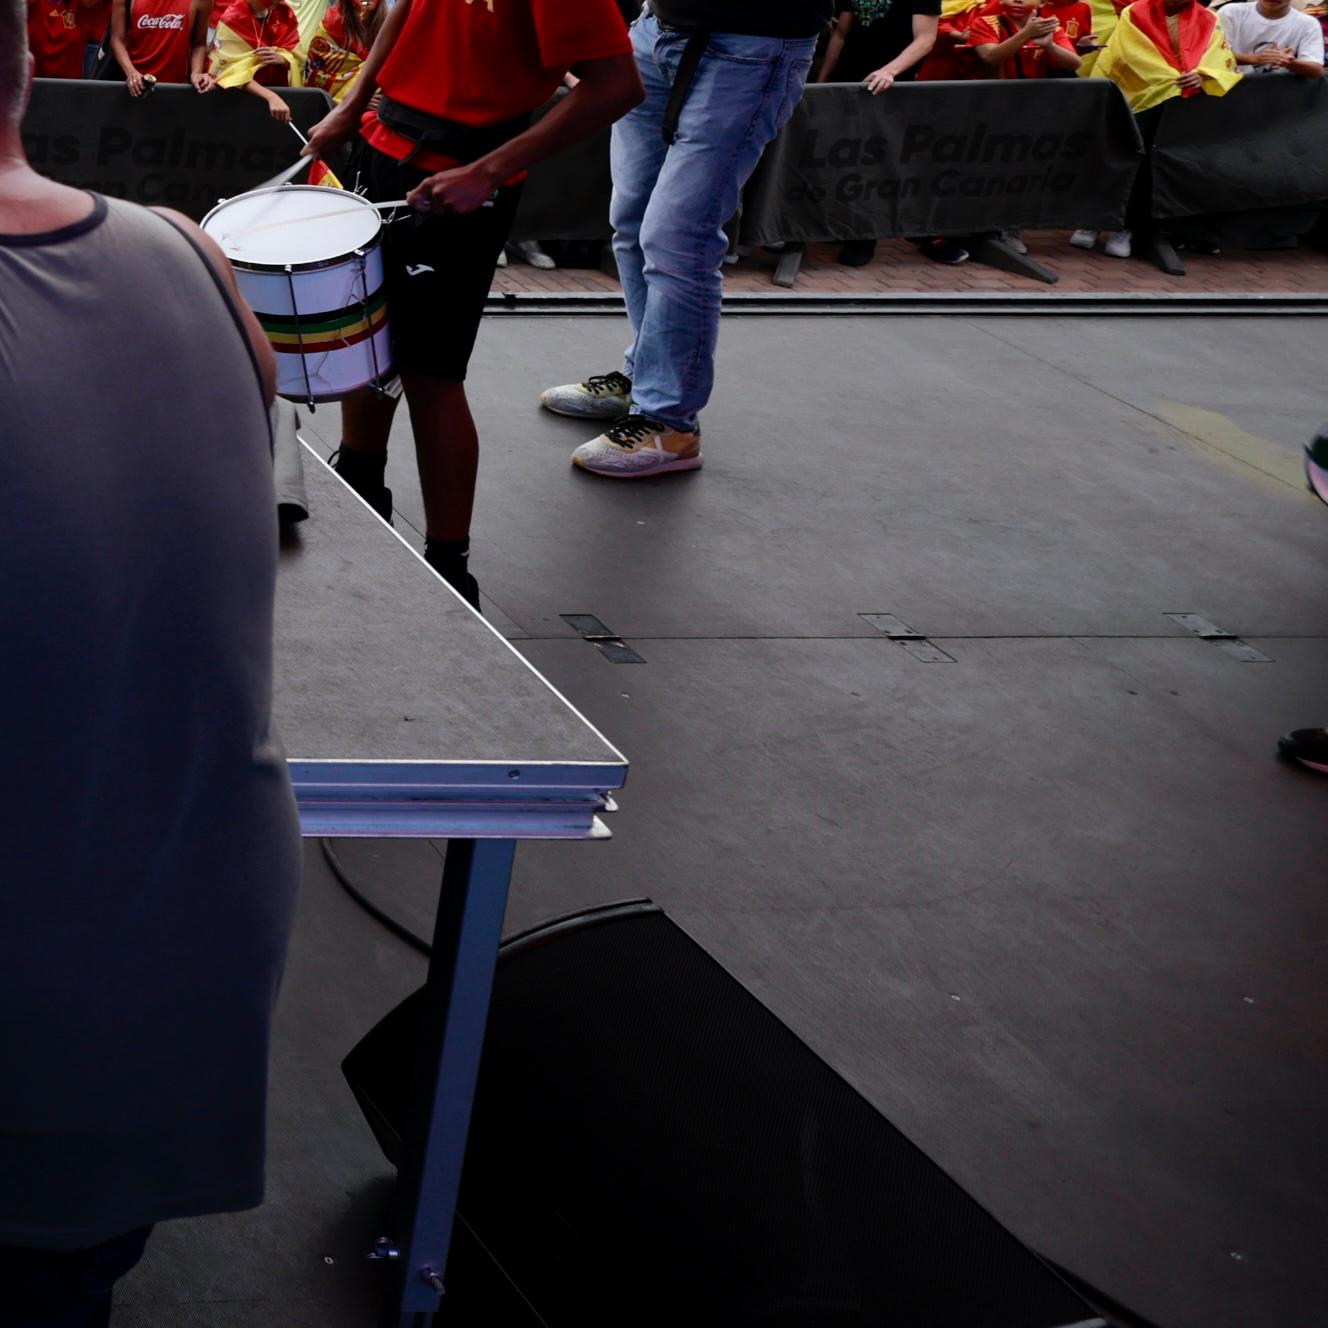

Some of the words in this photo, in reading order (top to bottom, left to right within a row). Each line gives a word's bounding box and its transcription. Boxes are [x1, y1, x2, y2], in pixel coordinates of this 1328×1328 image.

[137, 13, 185, 30] Coca-Cola
[23, 132, 81, 165] as
[798, 128, 889, 169] Las
[899, 123, 1095, 164] Palmas
[785, 183, 826, 203] de
[835, 173, 922, 203] Gran
[930, 163, 1079, 198] Canaria
